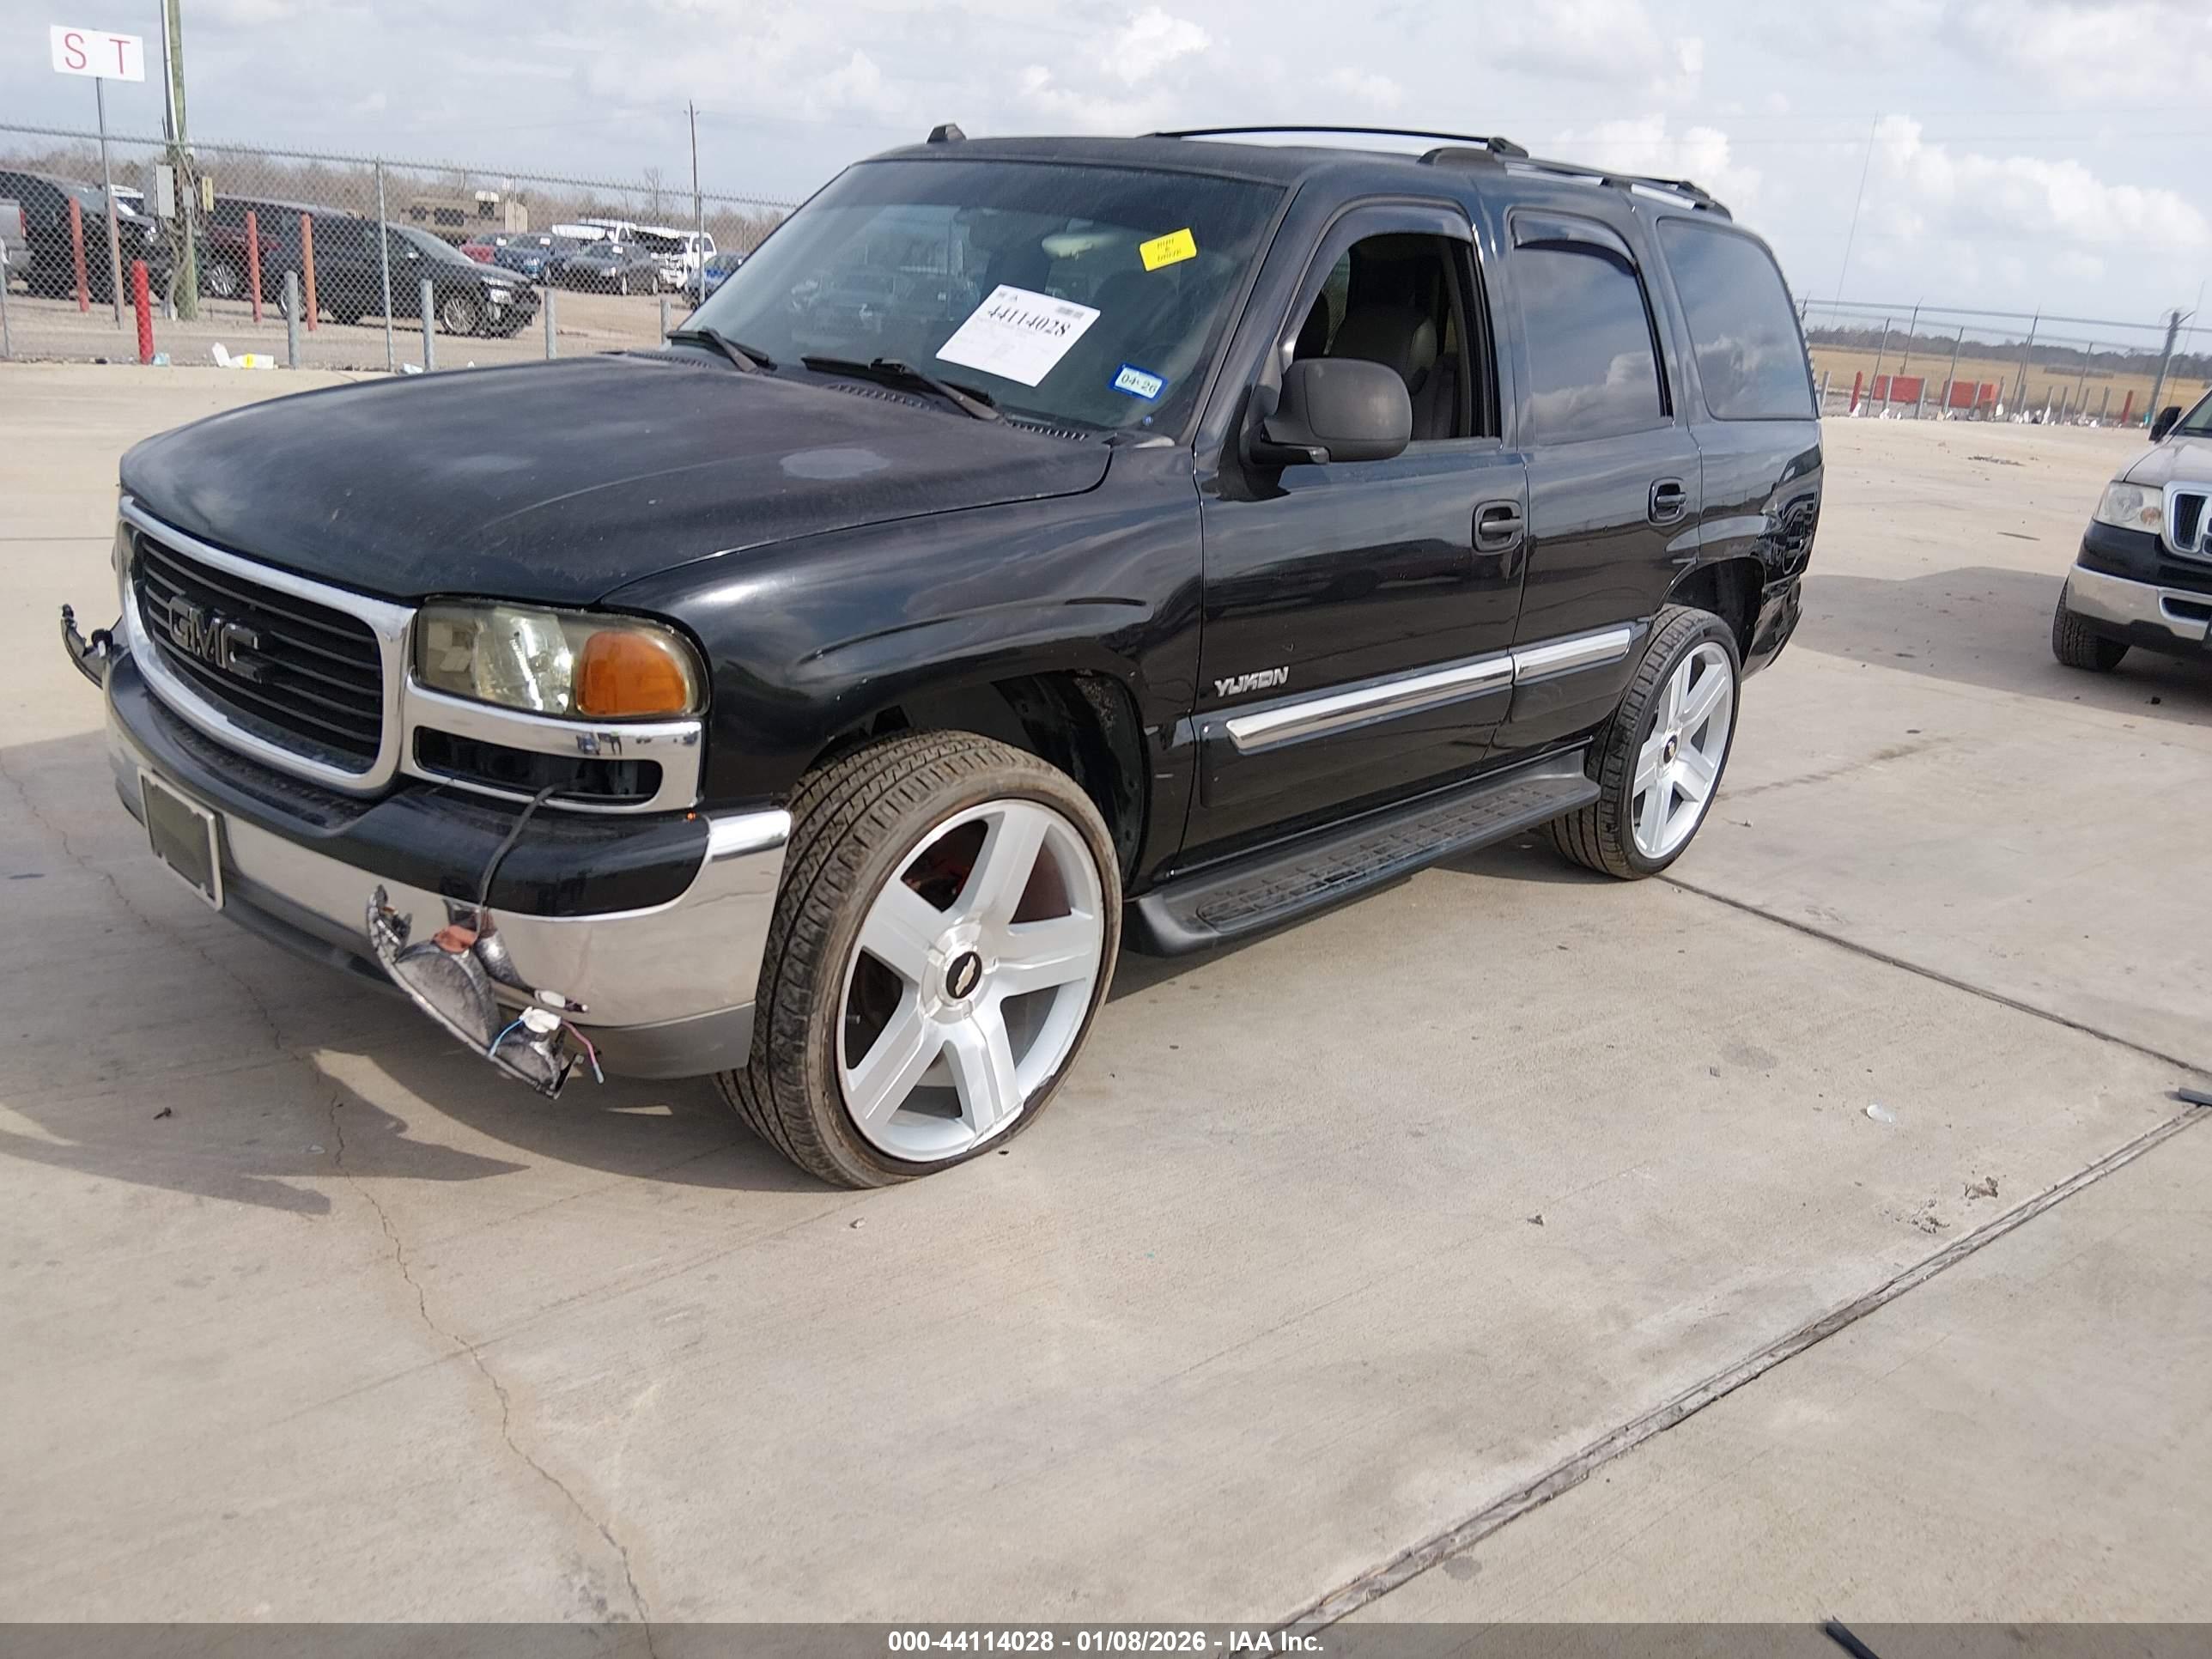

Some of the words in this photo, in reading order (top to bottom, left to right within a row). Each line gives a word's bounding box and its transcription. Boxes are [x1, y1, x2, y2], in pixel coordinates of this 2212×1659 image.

[988, 304, 1071, 337] 44114028
[168, 596, 262, 684] GMC
[1214, 665, 1290, 697] YUKON
